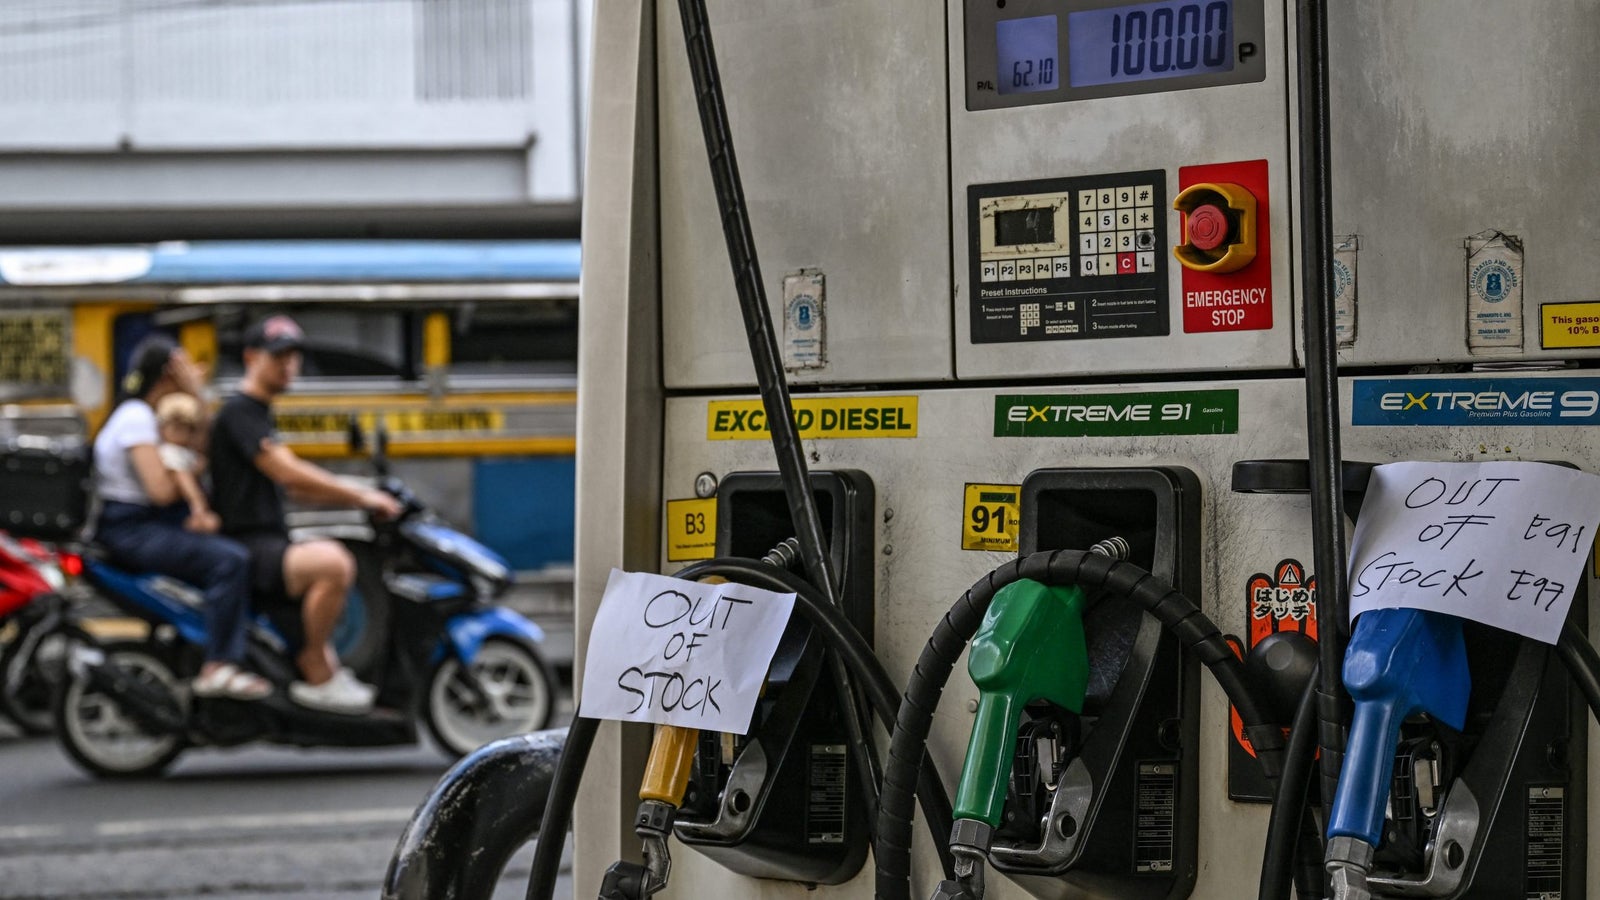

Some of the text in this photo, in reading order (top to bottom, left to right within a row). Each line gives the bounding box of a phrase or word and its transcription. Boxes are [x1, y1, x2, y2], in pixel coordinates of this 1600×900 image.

[1110, 1, 1229, 77] 100.00
[1239, 42, 1256, 63] P
[1013, 58, 1054, 87] 62.10
[977, 80, 994, 90] P/L
[1084, 195, 1091, 205] 7
[1102, 194, 1110, 204] 8
[1121, 192, 1129, 202] 9
[1084, 214, 1129, 227] 4 5 6
[1085, 236, 1130, 249] 1 2 3
[984, 263, 1068, 276] P1 P2 P3 P4 P5
[1085, 257, 1149, 271] 0 C L
[981, 287, 1048, 297] Preset Instructions
[1187, 288, 1266, 308] EMERGENCY
[981, 304, 986, 313] 1
[1092, 299, 1097, 307] 2
[1092, 322, 1098, 330] 3
[1212, 309, 1245, 326] STOP
[1552, 316, 1600, 325] This gaso
[1567, 326, 1600, 335] 10% B
[1007, 404, 1152, 422] EXTREME
[1161, 403, 1192, 421] 91
[1380, 390, 1599, 417] EXTREME 9
[714, 407, 912, 432] EXCD DIESEL
[1468, 410, 1552, 418] Premium Plus Gasoline
[1405, 477, 1520, 508] OUT
[685, 512, 705, 535] B3
[971, 505, 1005, 533] 91
[981, 537, 1011, 545] MINIMUM
[1418, 515, 1496, 550] OF
[1524, 514, 1585, 553] E91
[1353, 552, 1483, 597] STOCK
[1507, 570, 1565, 611] E97
[644, 590, 753, 630] OUT
[663, 632, 708, 662] OF
[618, 667, 721, 717] STOCK
